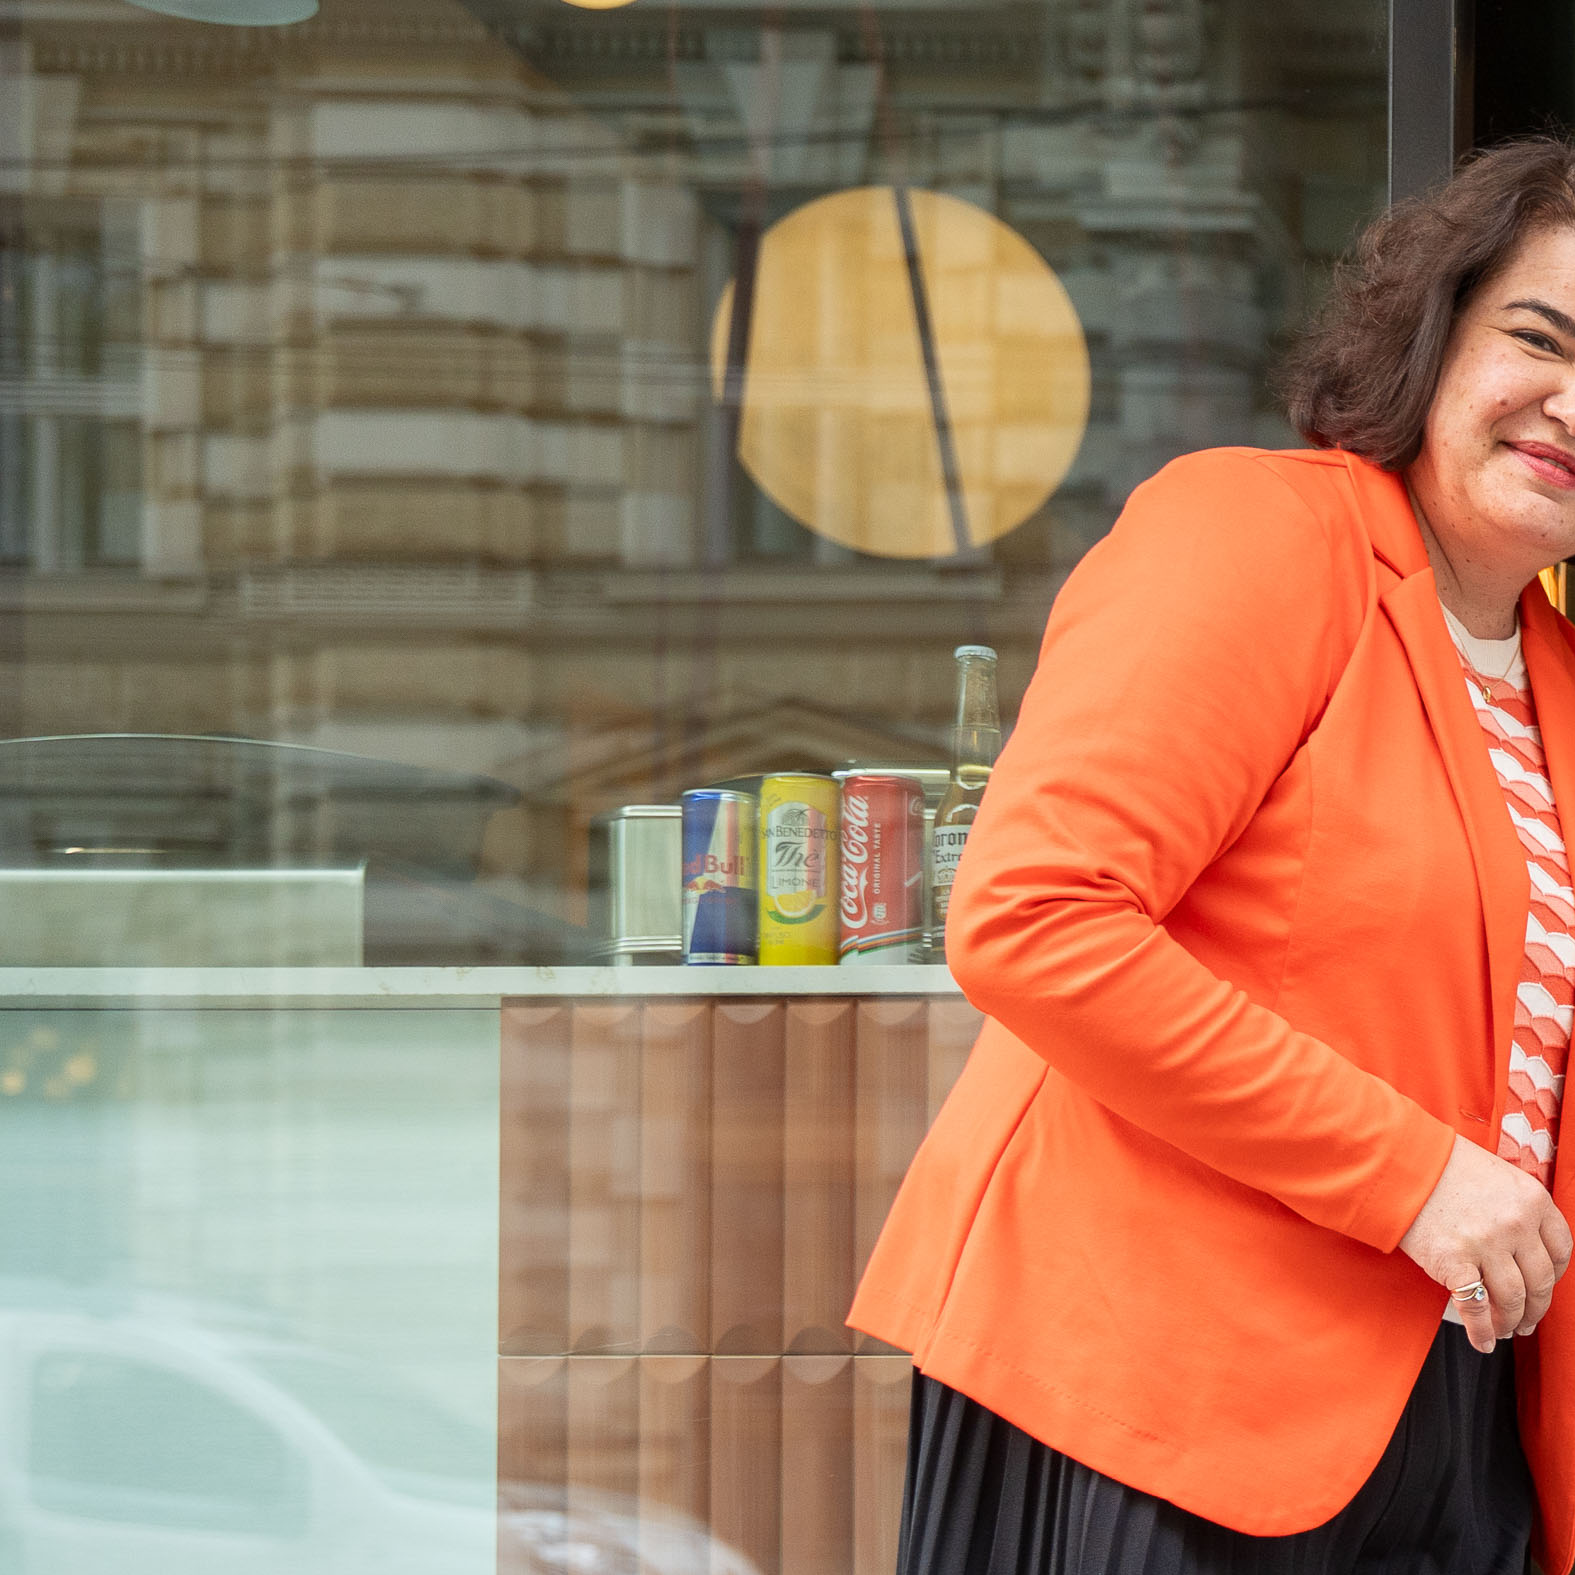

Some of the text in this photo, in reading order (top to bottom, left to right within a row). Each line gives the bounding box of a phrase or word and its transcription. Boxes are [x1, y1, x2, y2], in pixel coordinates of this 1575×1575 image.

[776, 825, 837, 841] BENEDETTO
[683, 853, 745, 875] ed Bull
[932, 850, 962, 864] Extr
[772, 876, 821, 889] LIMONE
